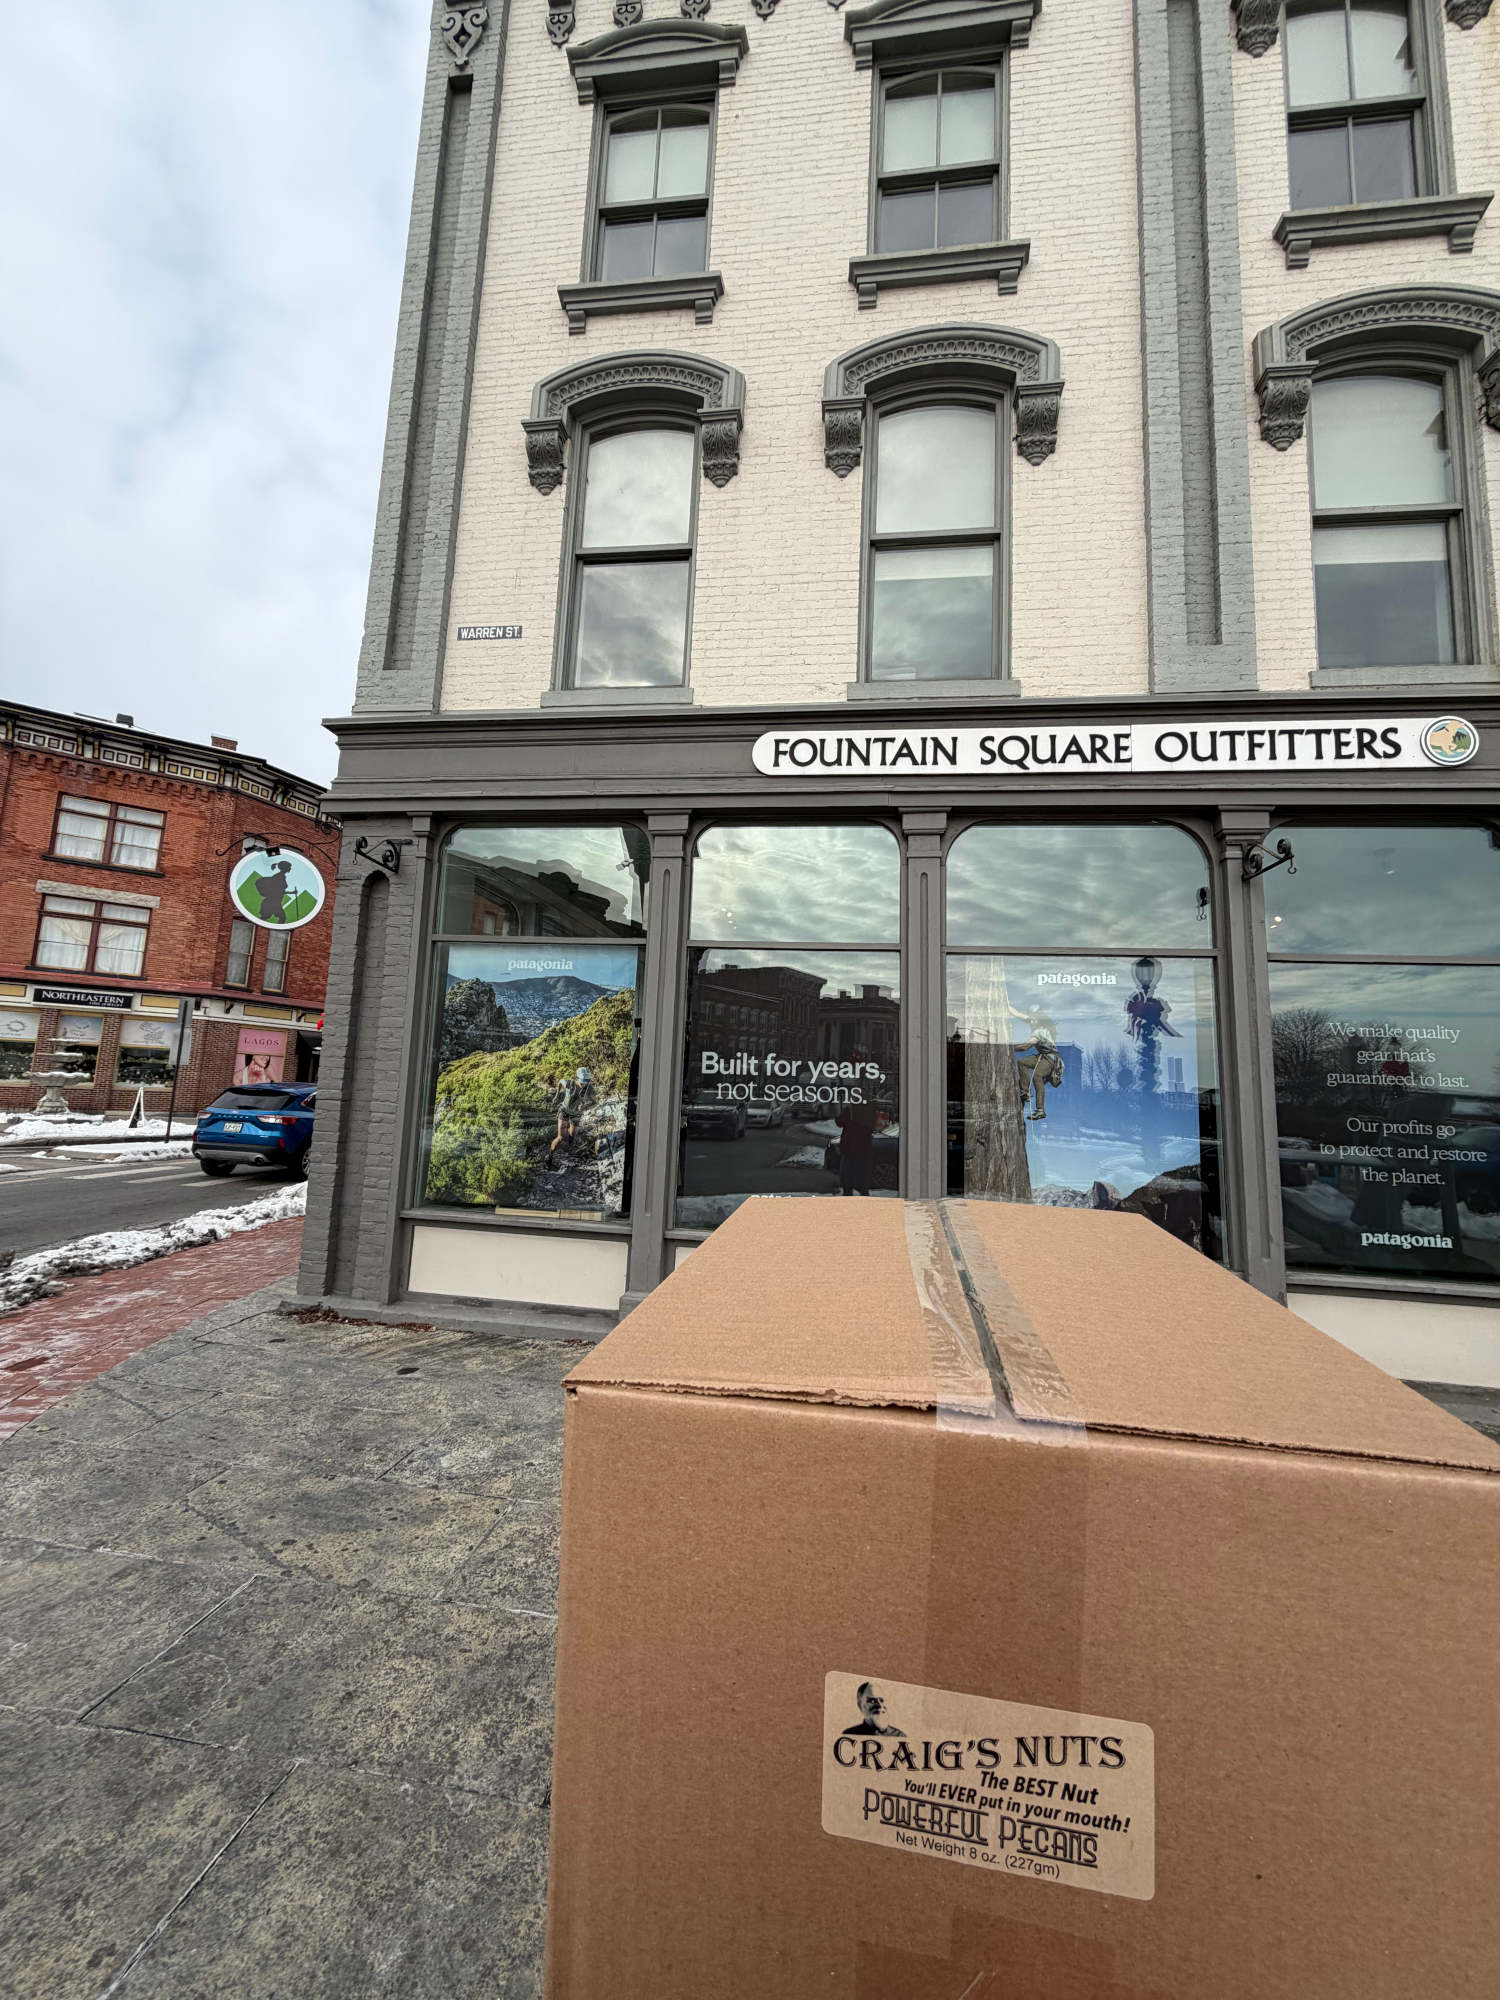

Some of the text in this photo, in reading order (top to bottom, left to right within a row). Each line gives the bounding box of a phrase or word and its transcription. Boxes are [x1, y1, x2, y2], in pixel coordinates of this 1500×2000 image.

[460, 627, 503, 639] WARREN
[772, 727, 1402, 770] FOUNTAIN SQUARE OUTFITTERS
[508, 959, 573, 972] patagonia
[1037, 972, 1117, 987] patagonia
[42, 990, 124, 1004] NORTHEASTERN
[244, 1037, 280, 1047] LAGOS
[1328, 1022, 1460, 1043] We make quality
[1357, 1048, 1437, 1064] gear that's
[701, 1051, 887, 1084] Built for years,
[1327, 1071, 1470, 1088] guaranteed to last.
[716, 1081, 868, 1105] not seasons.
[1346, 1117, 1456, 1140] Our profits go
[1319, 1143, 1488, 1163] to protect and restore
[1362, 1167, 1446, 1187] the planet.
[1361, 1232, 1453, 1250] patagonia
[833, 1735, 1127, 1772] CRAIG'S NUTS
[980, 1770, 1100, 1805] The BEST Nut
[904, 1778, 1131, 1834] You'll EVER put in your mouth!
[862, 1787, 1099, 1869] POWERFUL PECANS
[896, 1831, 1061, 1880] Net Weight 8 oz. (227gm)
